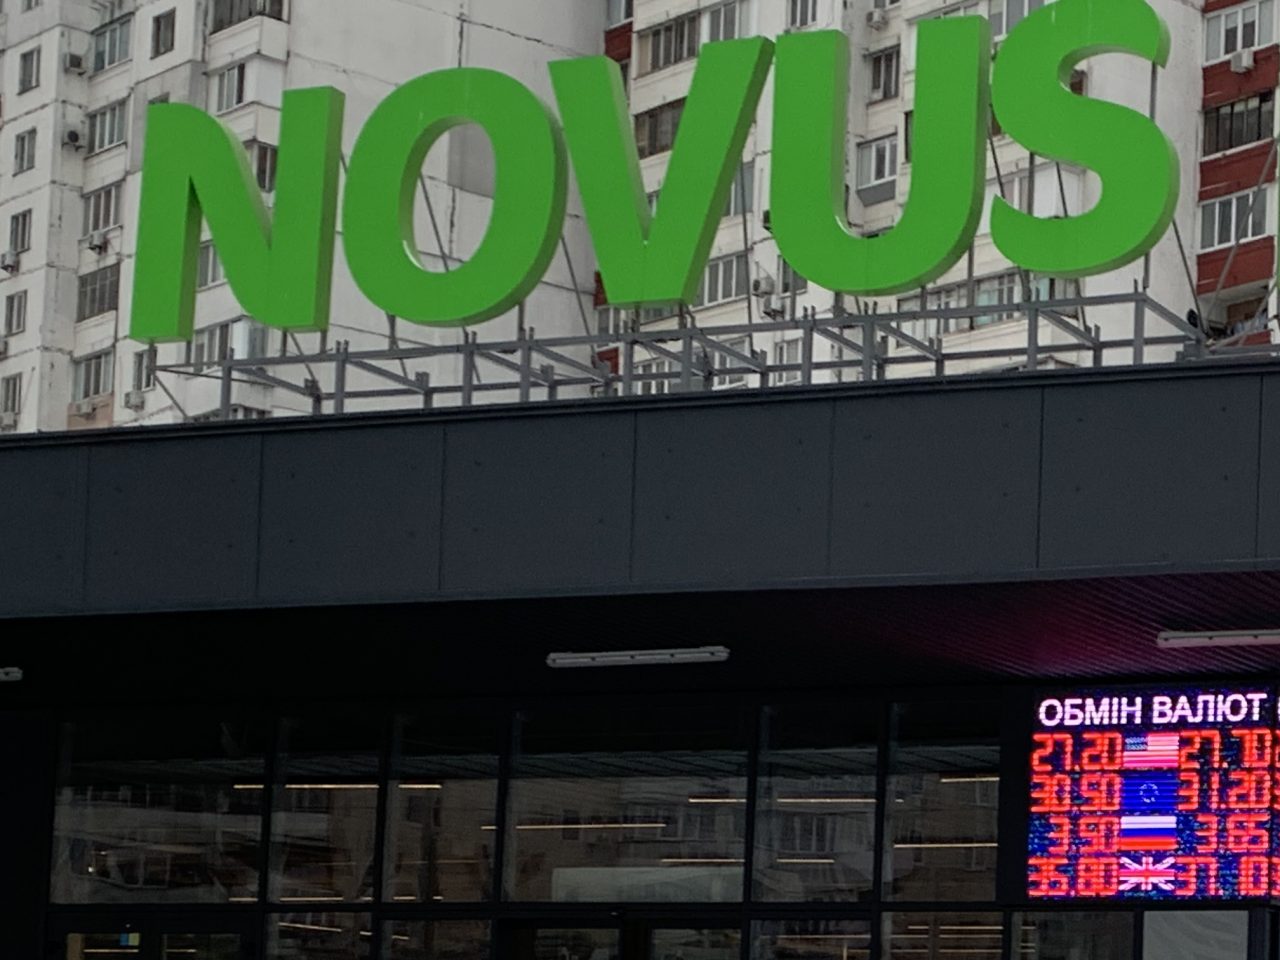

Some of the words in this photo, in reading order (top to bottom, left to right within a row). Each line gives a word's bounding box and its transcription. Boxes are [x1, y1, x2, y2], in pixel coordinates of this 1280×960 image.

[130, 0, 1178, 343] NOVUS
[1039, 697, 1142, 726] ОБМІН
[1152, 693, 1268, 723] ВАЛЮТ
